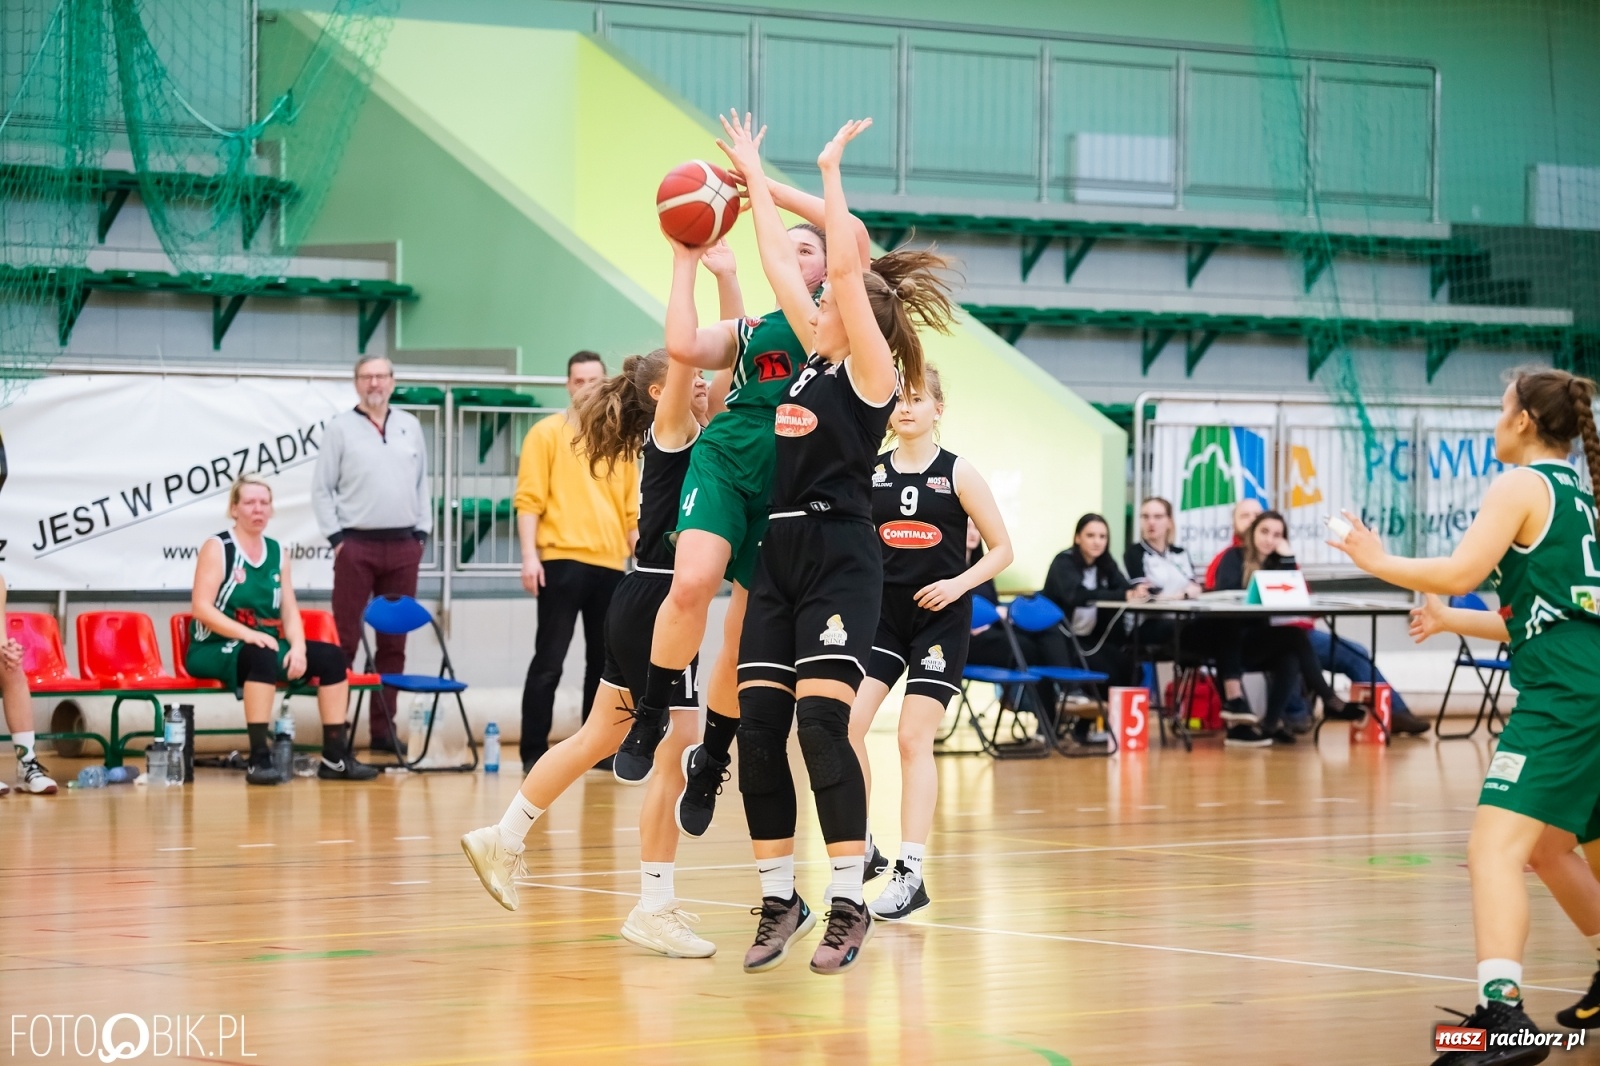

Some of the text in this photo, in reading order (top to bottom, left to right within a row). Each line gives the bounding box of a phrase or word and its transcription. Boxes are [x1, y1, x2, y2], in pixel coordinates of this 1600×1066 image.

[789, 367, 817, 397] 8
[33, 497, 110, 551] JEST
[120, 483, 152, 517] W
[164, 421, 325, 504] PORZĄDK
[900, 485, 919, 516] 9
[682, 488, 698, 517] 4
[926, 664, 944, 672] KING
[1125, 694, 1146, 737] 5
